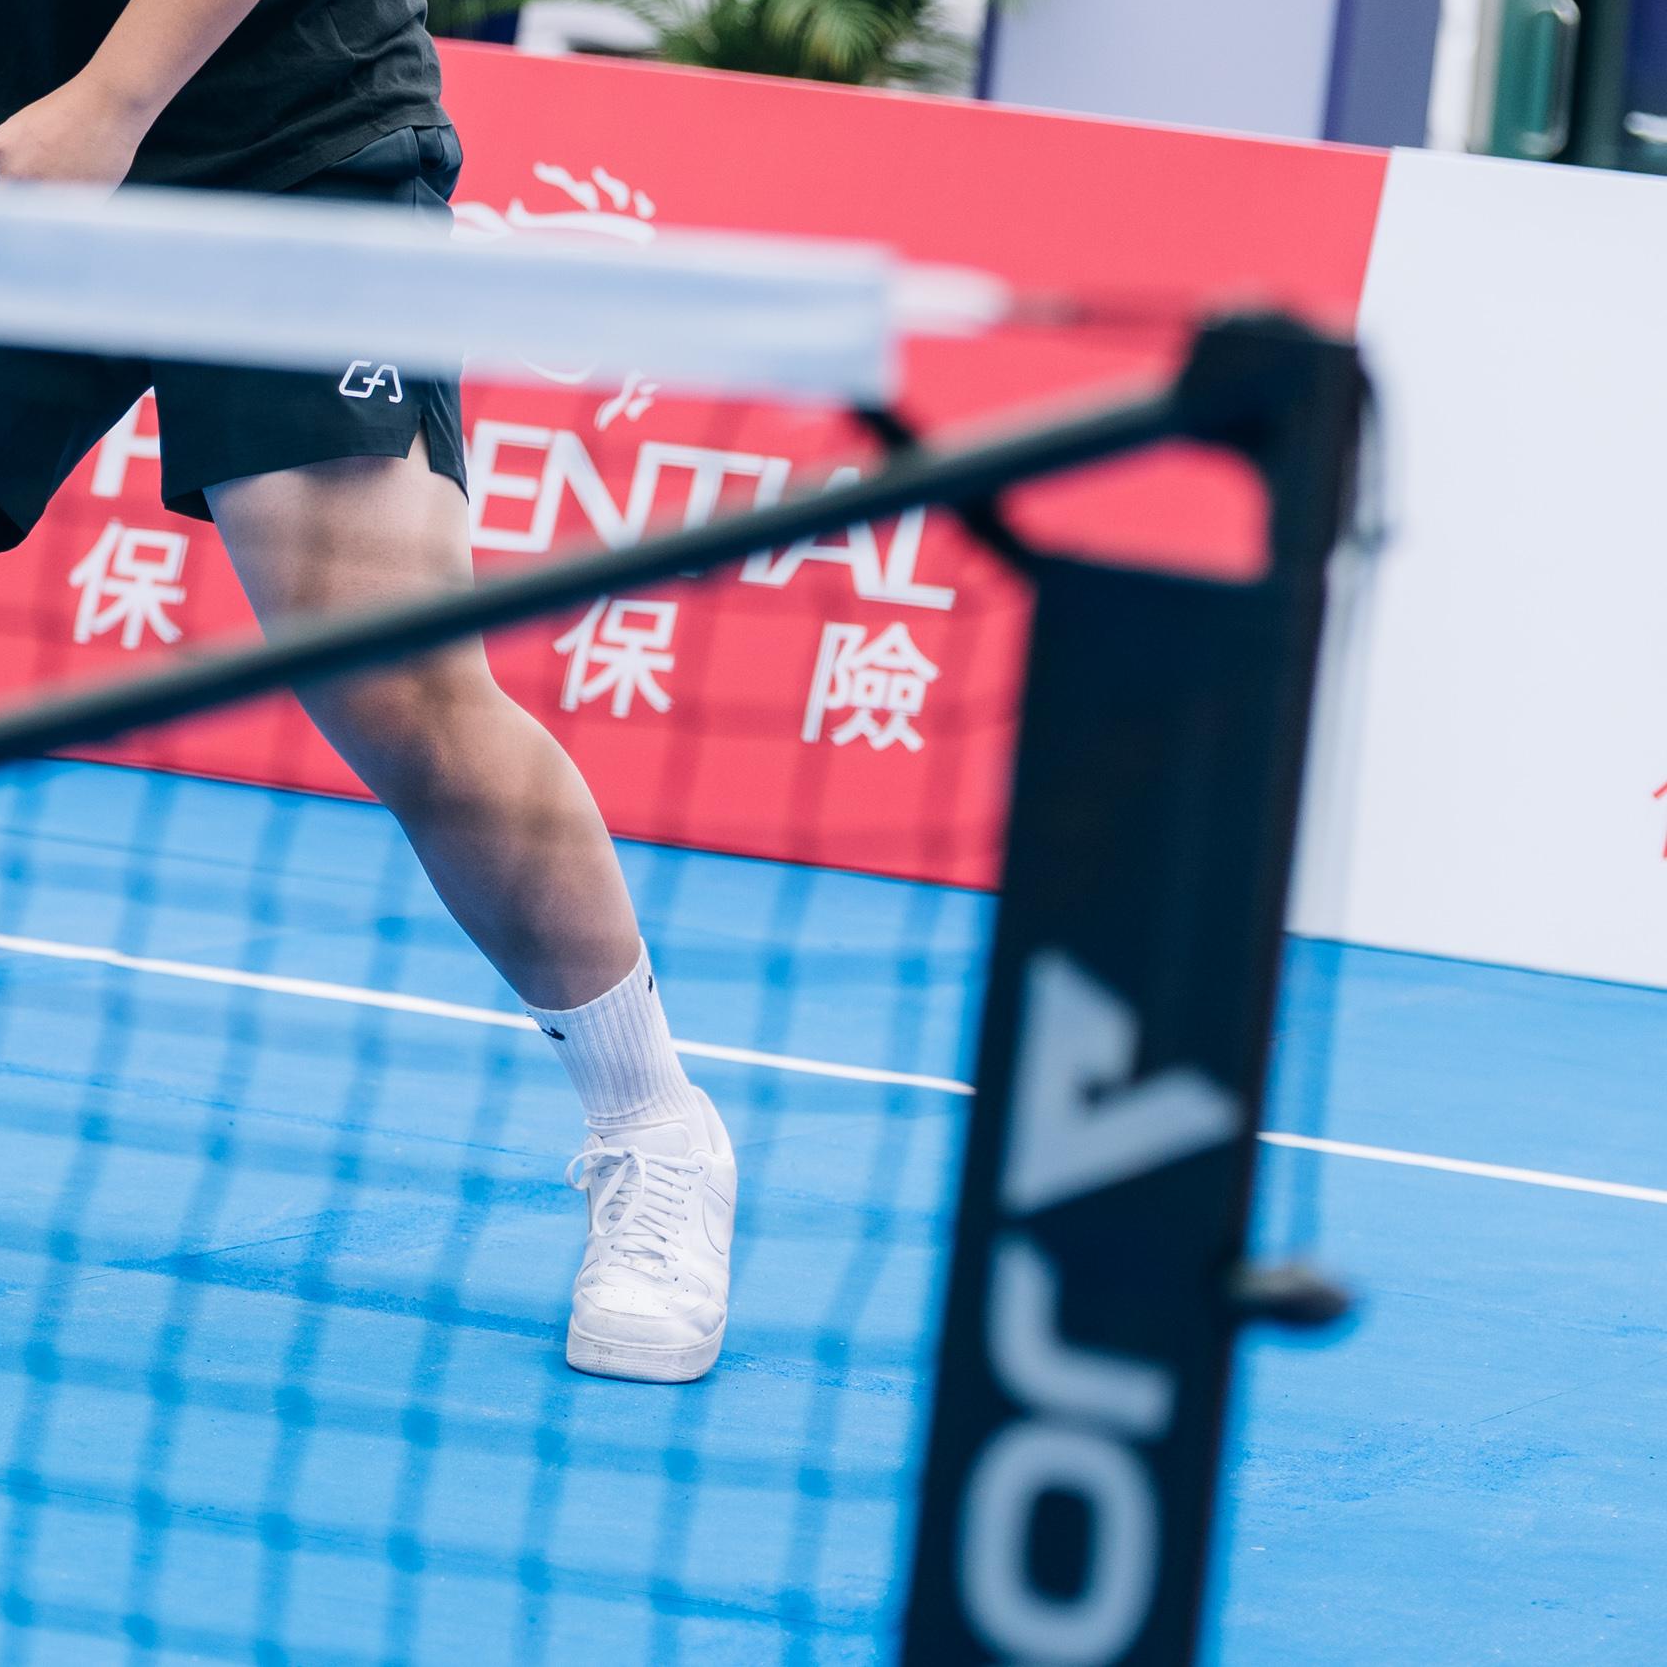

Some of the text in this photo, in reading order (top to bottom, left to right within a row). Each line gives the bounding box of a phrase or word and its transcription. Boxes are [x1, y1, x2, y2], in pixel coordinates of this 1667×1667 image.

[90, 385, 957, 610] PENTIAL
[69, 517, 941, 755] 保保險
